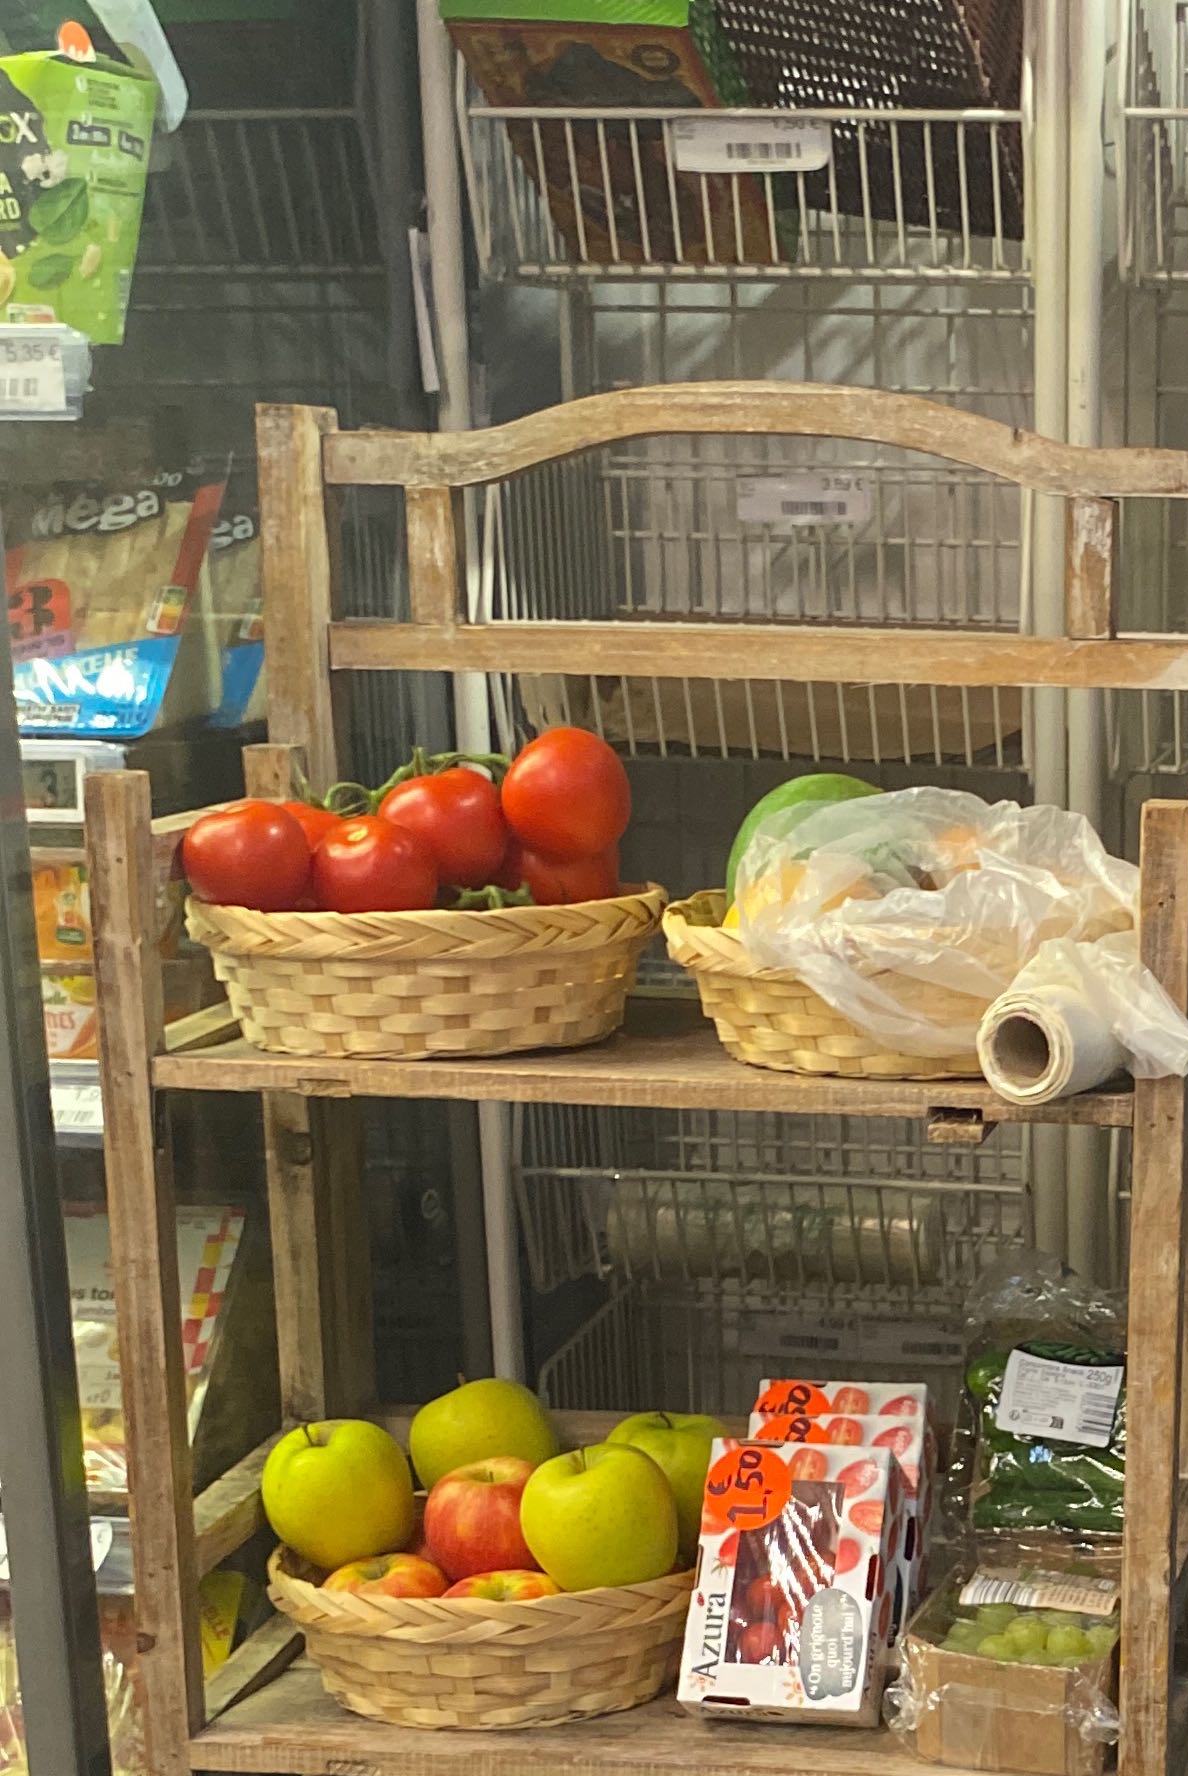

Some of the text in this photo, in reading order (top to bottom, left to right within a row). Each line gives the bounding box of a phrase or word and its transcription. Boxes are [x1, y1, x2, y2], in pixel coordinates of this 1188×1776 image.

[1086, 1369, 1113, 1387] 250g
[727, 1449, 773, 1521] 1,50
[691, 1590, 727, 1680] Azura
[826, 1637, 840, 1668] quoi
